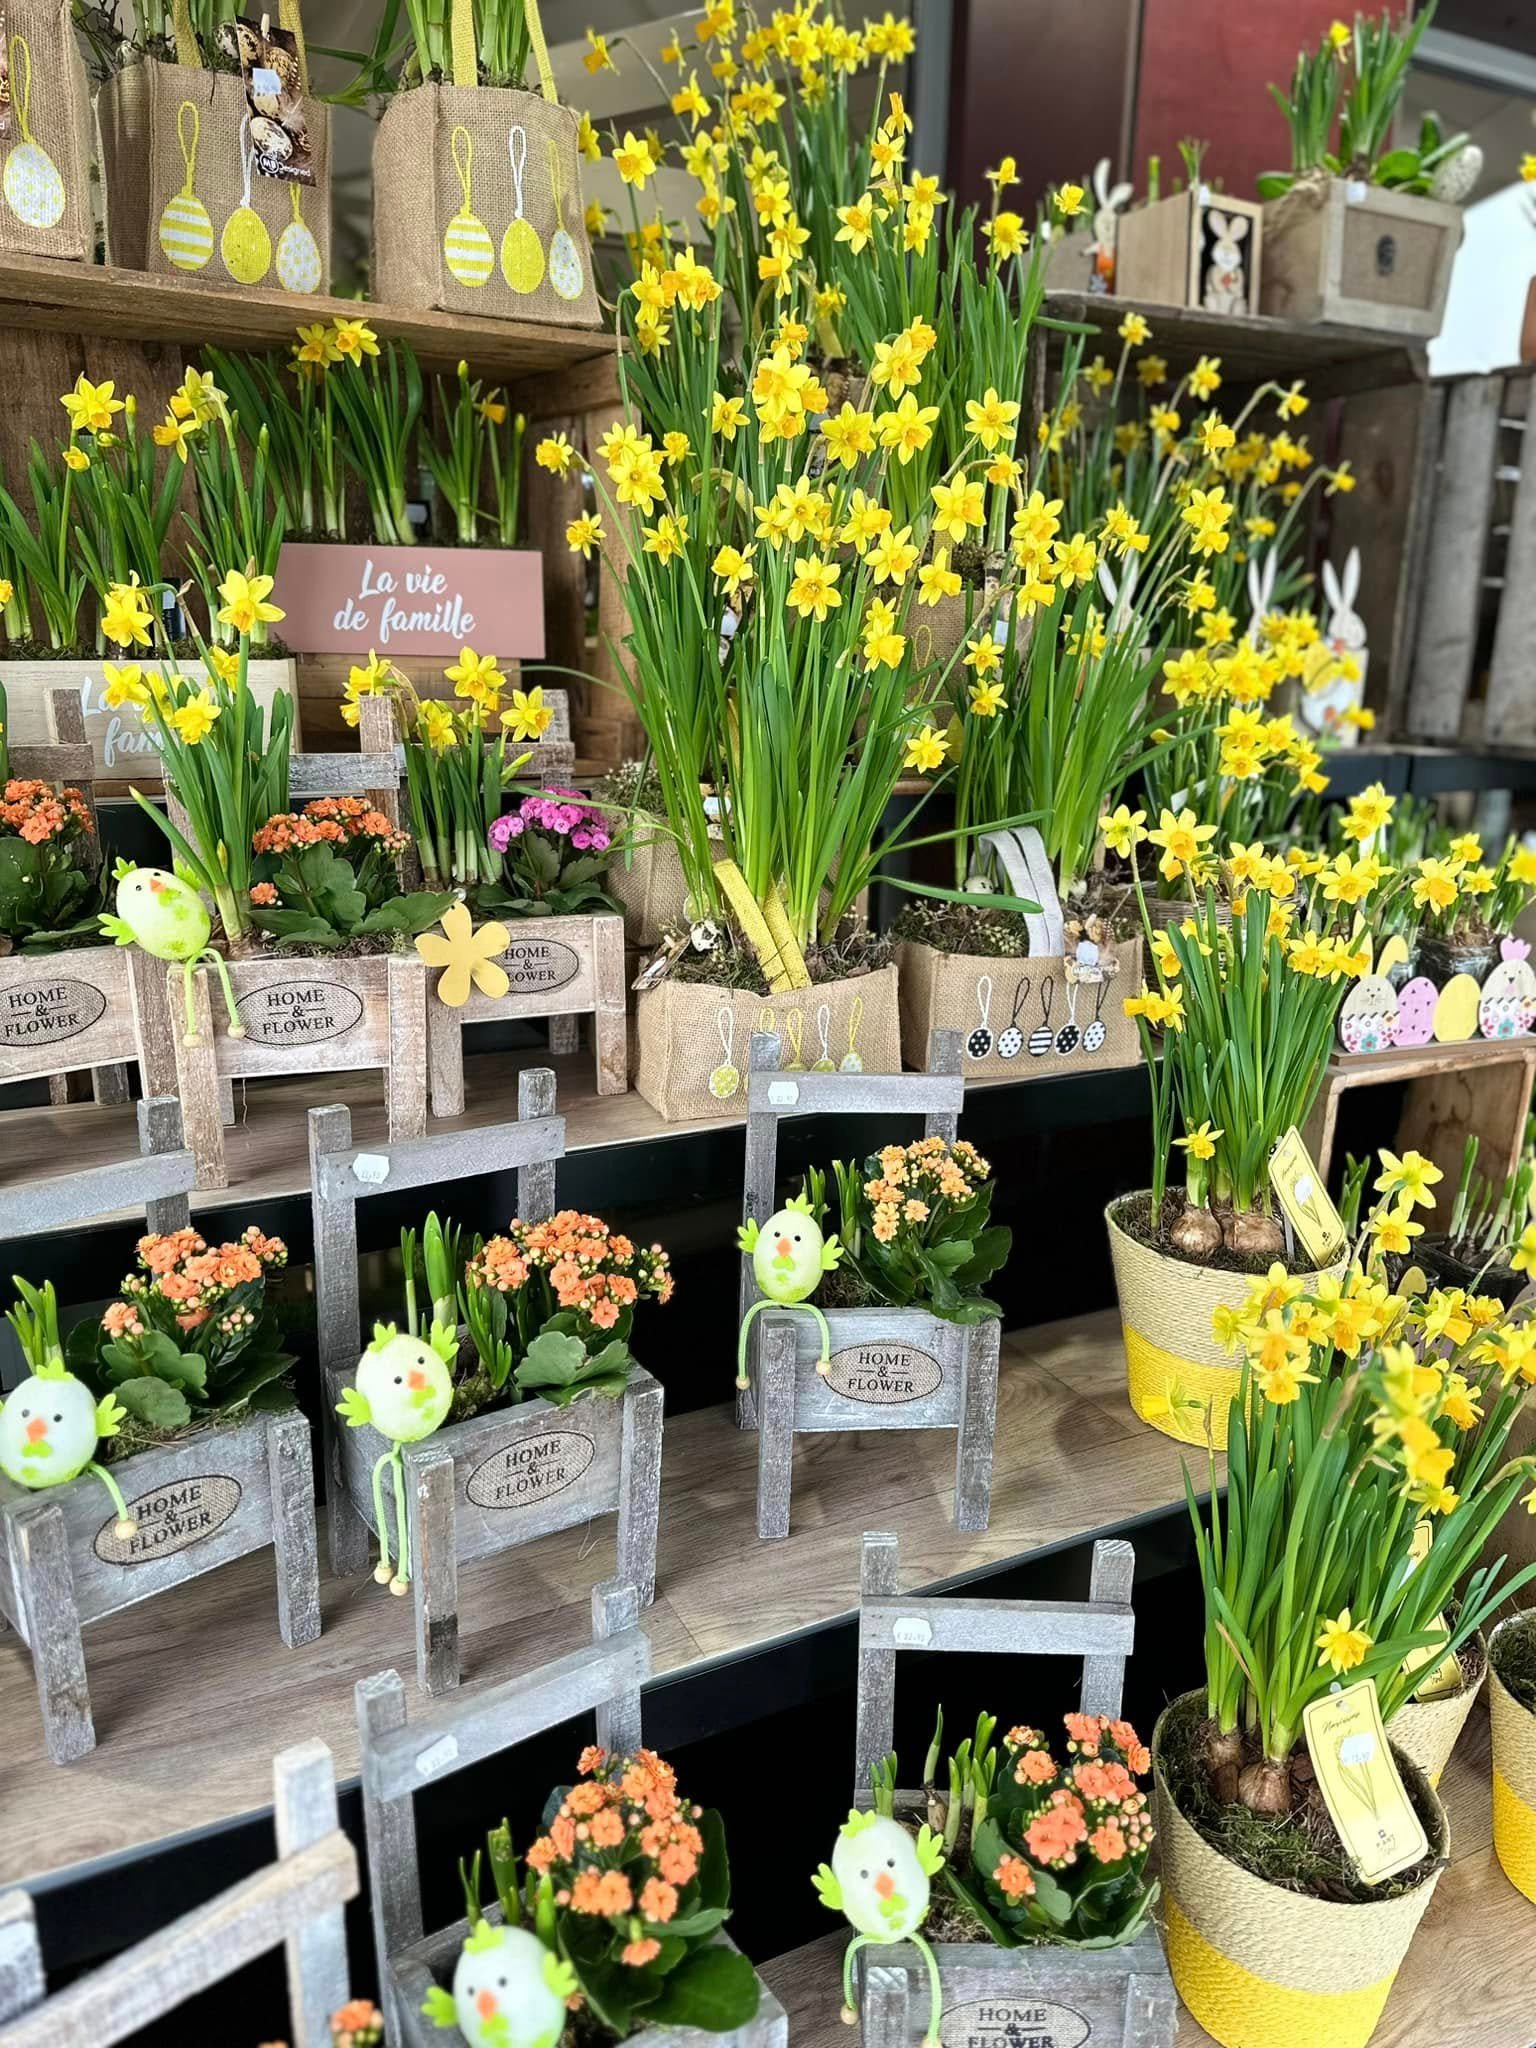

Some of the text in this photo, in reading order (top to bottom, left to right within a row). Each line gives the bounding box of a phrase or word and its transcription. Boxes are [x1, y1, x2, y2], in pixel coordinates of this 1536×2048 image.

[278, 161, 311, 176] Designed
[358, 559, 448, 600] La vie
[333, 594, 477, 644] de famille
[504, 946, 551, 960] HOME
[523, 958, 533, 970] &
[507, 970, 557, 983] LOWER
[8, 986, 68, 1008] HOME
[267, 989, 325, 1007] HOME
[35, 1004, 50, 1017] &
[292, 1005, 305, 1018] &
[5, 1013, 80, 1038] FLOWER
[262, 1016, 336, 1035] FLOWER
[859, 1352, 911, 1367] HOME
[877, 1366, 889, 1378] &
[848, 1379, 914, 1393] FLOWER
[506, 1440, 562, 1468] HOME
[527, 1461, 540, 1475] &
[495, 1467, 565, 1500] FLOWER
[136, 1485, 203, 1520] HOME
[164, 1509, 179, 1525] &
[129, 1511, 213, 1555] FLOWER
[978, 2007, 1048, 2022] HOME
[1004, 2022, 1022, 2037] &
[967, 2036, 1054, 2048] FLOWER
